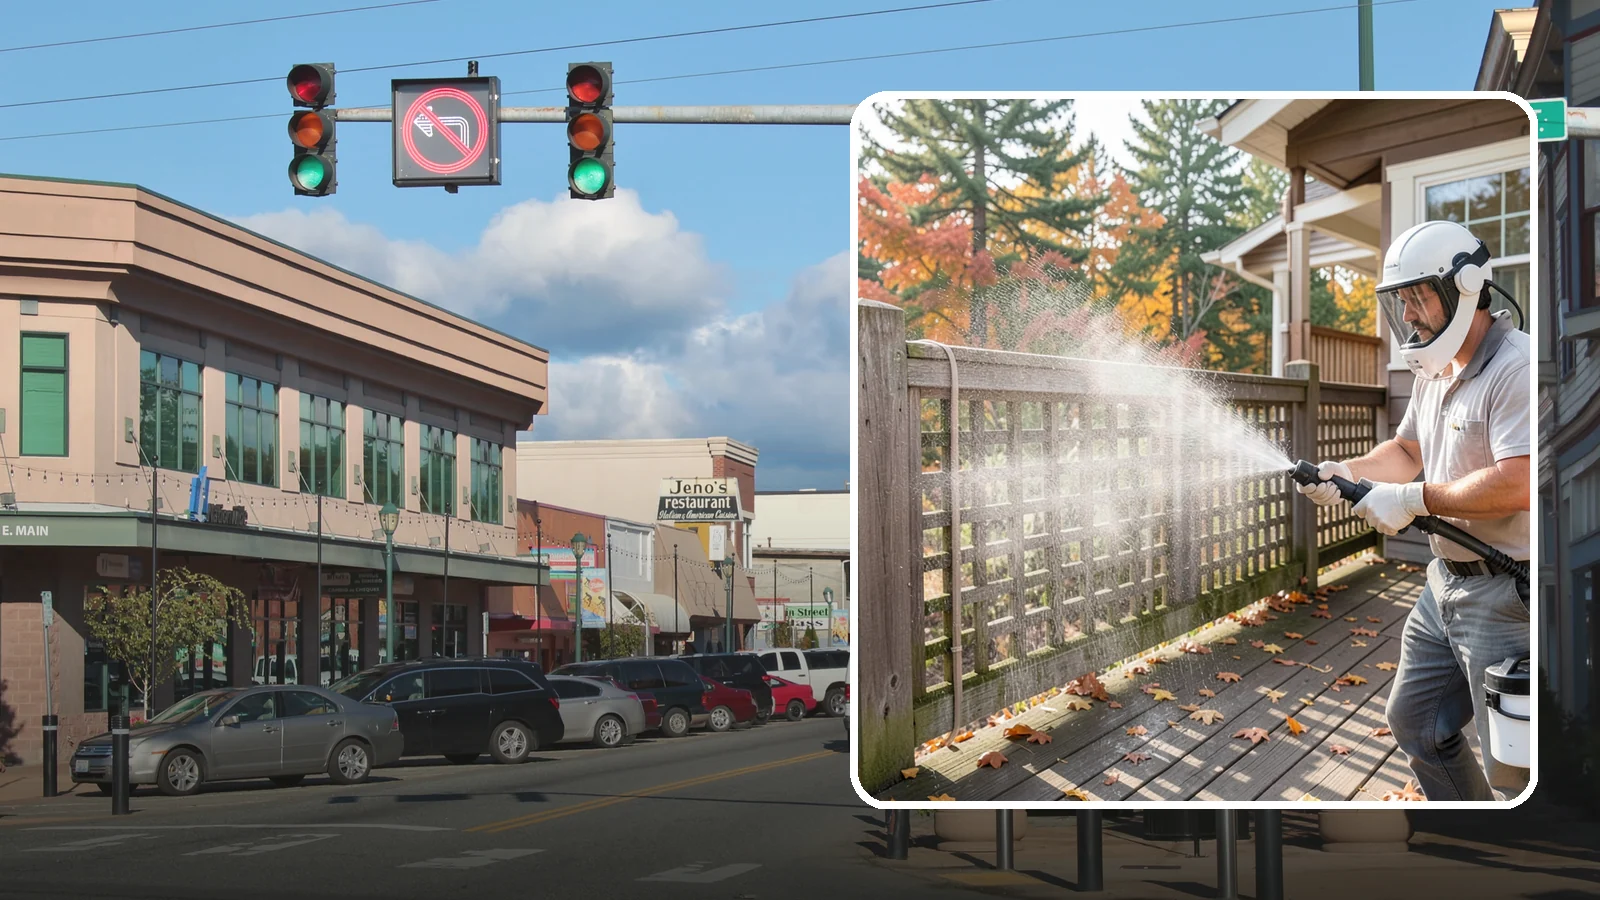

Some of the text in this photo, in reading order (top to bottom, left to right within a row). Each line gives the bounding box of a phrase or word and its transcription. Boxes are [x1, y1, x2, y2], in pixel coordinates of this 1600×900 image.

[670, 480, 728, 495] Jeno's
[665, 496, 731, 509] restaurant
[658, 509, 681, 520] Italian
[685, 509, 715, 519] American
[715, 509, 738, 519] Cuisine
[2, 525, 49, 537] E. MAIN
[785, 607, 795, 617] in
[797, 607, 829, 617] Street
